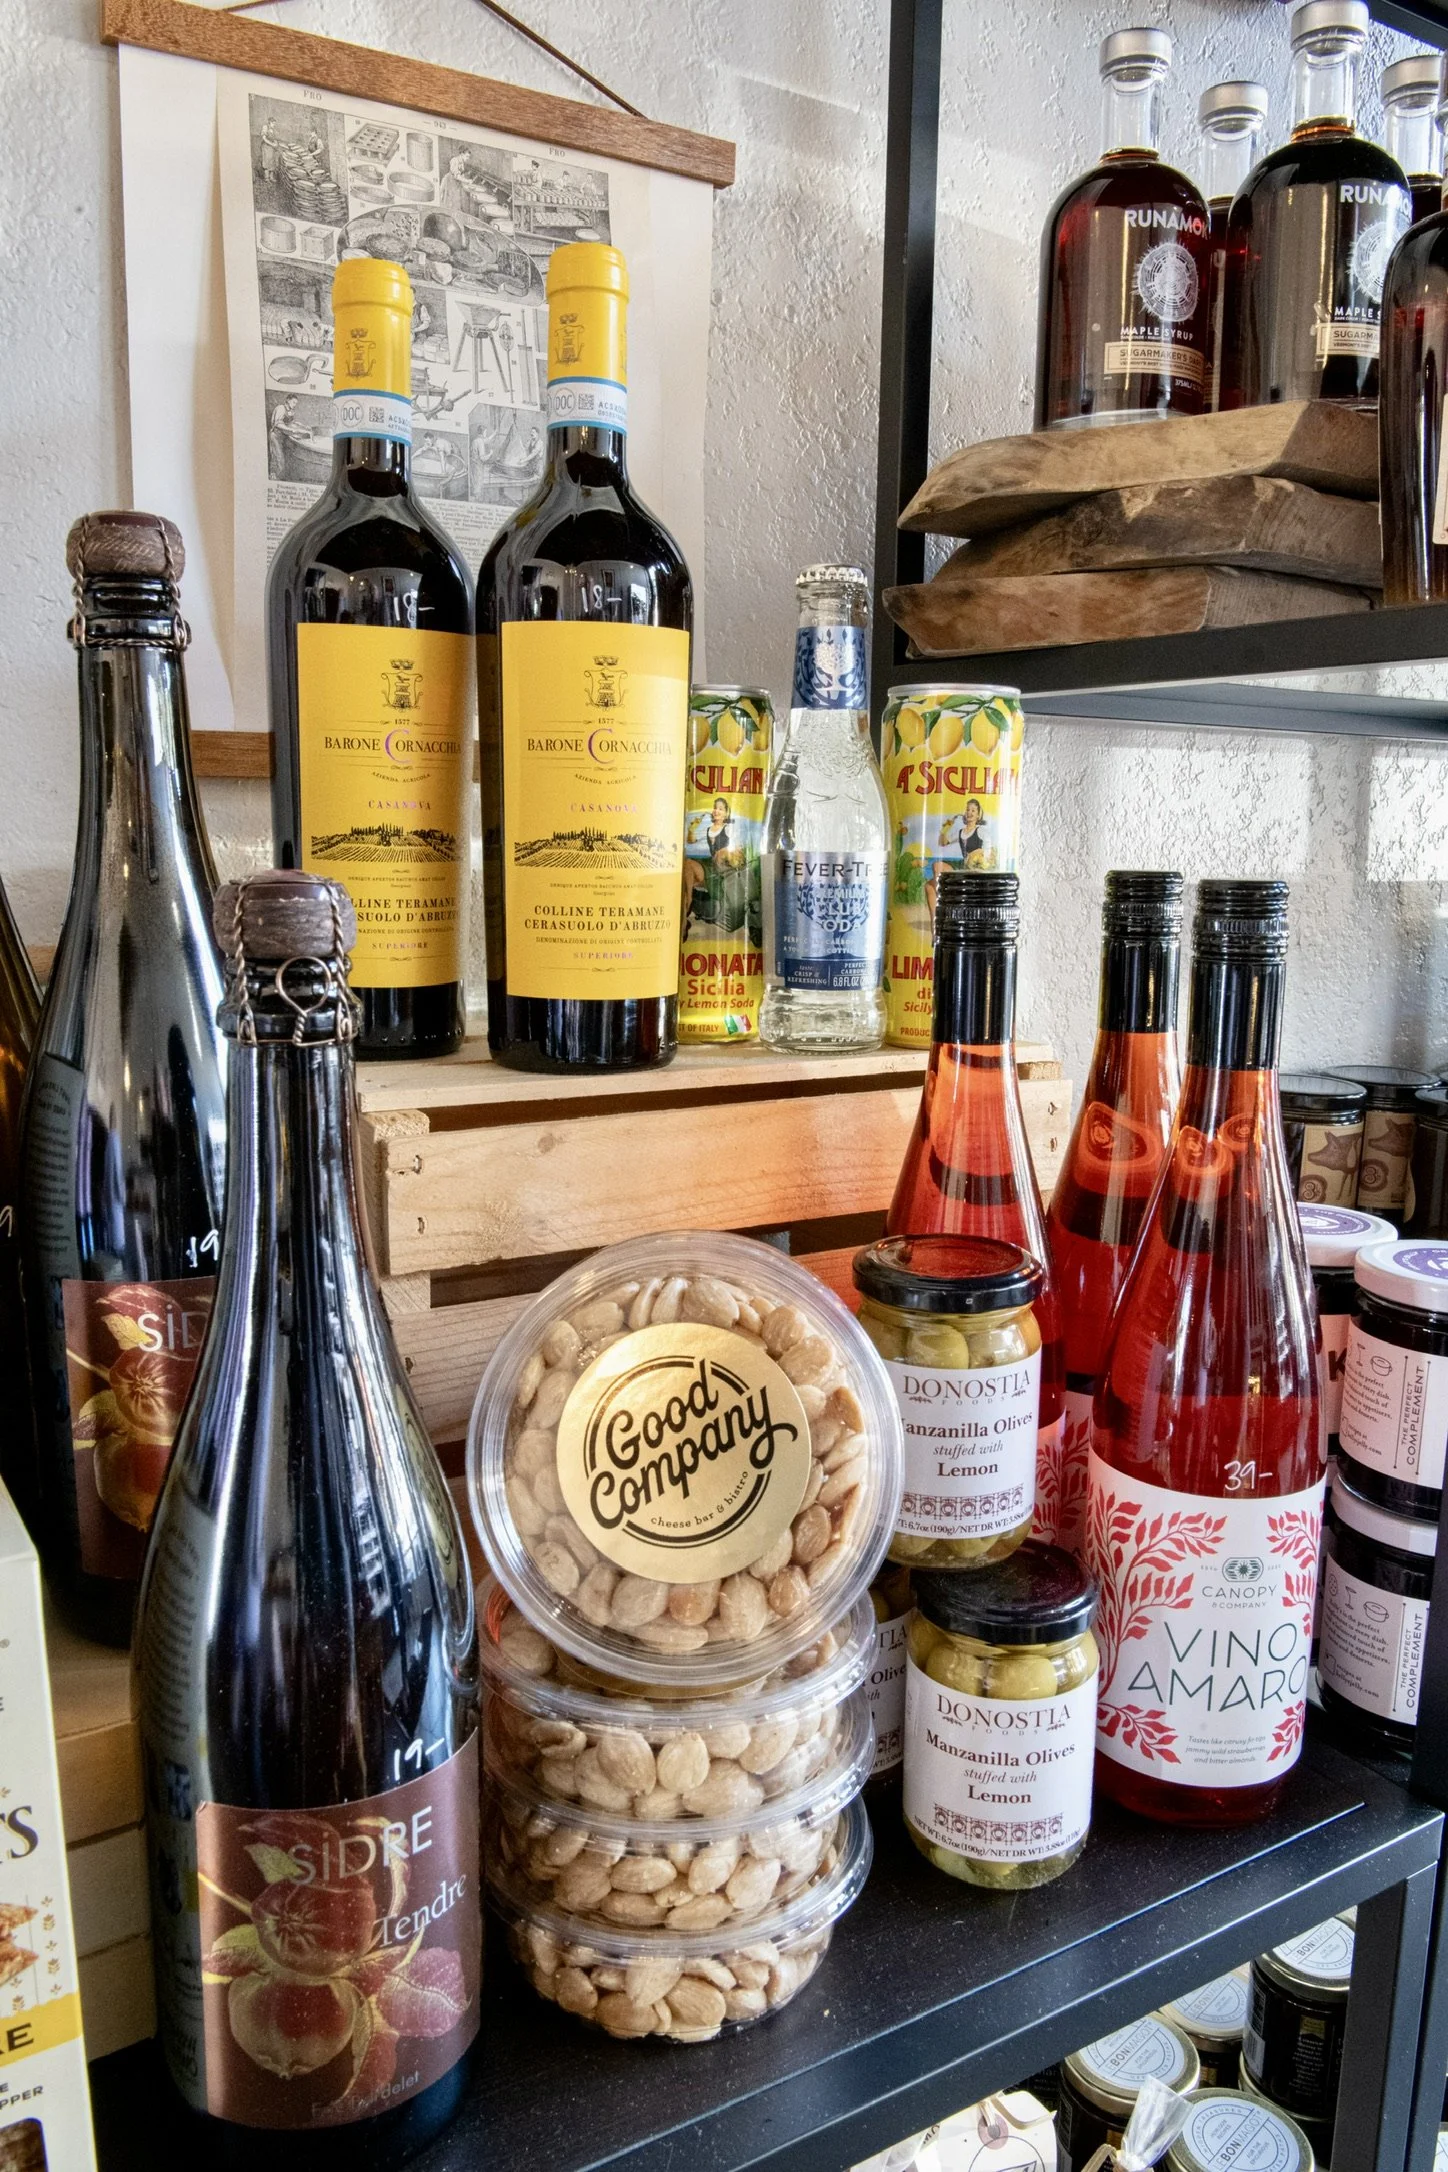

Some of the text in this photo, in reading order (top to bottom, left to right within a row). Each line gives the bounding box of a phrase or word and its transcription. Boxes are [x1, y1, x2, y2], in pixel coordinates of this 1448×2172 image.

[303, 89, 322, 101] FRO
[549, 148, 566, 158] FRO
[1335, 306, 1373, 318] MAPLE
[1120, 326, 1160, 336] MAPLE
[1165, 329, 1194, 341] SYRUP
[555, 396, 573, 410] DOC
[342, 406, 361, 421] DOC
[324, 737, 381, 751] BARONE
[527, 728, 672, 764] BARONE CORNACCHIA
[372, 772, 431, 783] AZIENDA AGRICOLA
[574, 773, 602, 785] AZIENDA
[368, 801, 431, 811] CASANOVA
[570, 803, 638, 813] CASANOVA
[351, 898, 391, 909] LLINE
[357, 912, 401, 922] SUOLO
[534, 905, 665, 917] COLLINE TERAMANE
[524, 918, 671, 931] CERASUOLO D'ABRUZZO
[372, 942, 428, 950] SUPERIORE
[536, 937, 587, 945] DENOMINAZIONE
[574, 952, 633, 960] SUPERIORE
[787, 976, 829, 985] REFRESHING
[917, 987, 931, 1000] di
[688, 999, 727, 1009] Lemon
[730, 998, 754, 1009] Soda
[687, 1023, 696, 1033] OF
[699, 1024, 720, 1033] ITALY
[900, 1026, 930, 1037] PRODUC
[904, 1369, 1031, 1399] DONOSTIA
[606, 1358, 719, 1470] Good
[1401, 1382, 1413, 1446] THE PERFECT
[1406, 1366, 1424, 1465] COMPLEMENT
[994, 1412, 1033, 1435] Olives
[590, 1385, 798, 1529] Company
[933, 1440, 1004, 1460] stuffed with
[937, 1462, 998, 1477] Lemon
[651, 1471, 749, 1529] cheese bar & bistro
[981, 1522, 993, 1531] DR
[1202, 1584, 1278, 1599] CANOPY
[1219, 1601, 1266, 1609] COMPANY
[1357, 1620, 1380, 1634] perfect
[1164, 1622, 1298, 1669] VINO
[1403, 1629, 1412, 1669] PERFECT
[1406, 1613, 1423, 1708] COMPLEMENT
[871, 1664, 907, 1685] Olive
[1127, 1655, 1307, 1712] AMARO
[937, 1693, 1071, 1729] DONOSTIA
[1188, 1735, 1210, 1745] Tastes
[926, 1728, 1020, 1767] Manzanilla
[1025, 1743, 1075, 1766] Olives
[963, 1768, 1037, 1784] stuffed with
[968, 1784, 1032, 1804] Lemon
[376, 1872, 469, 1949] Tendre
